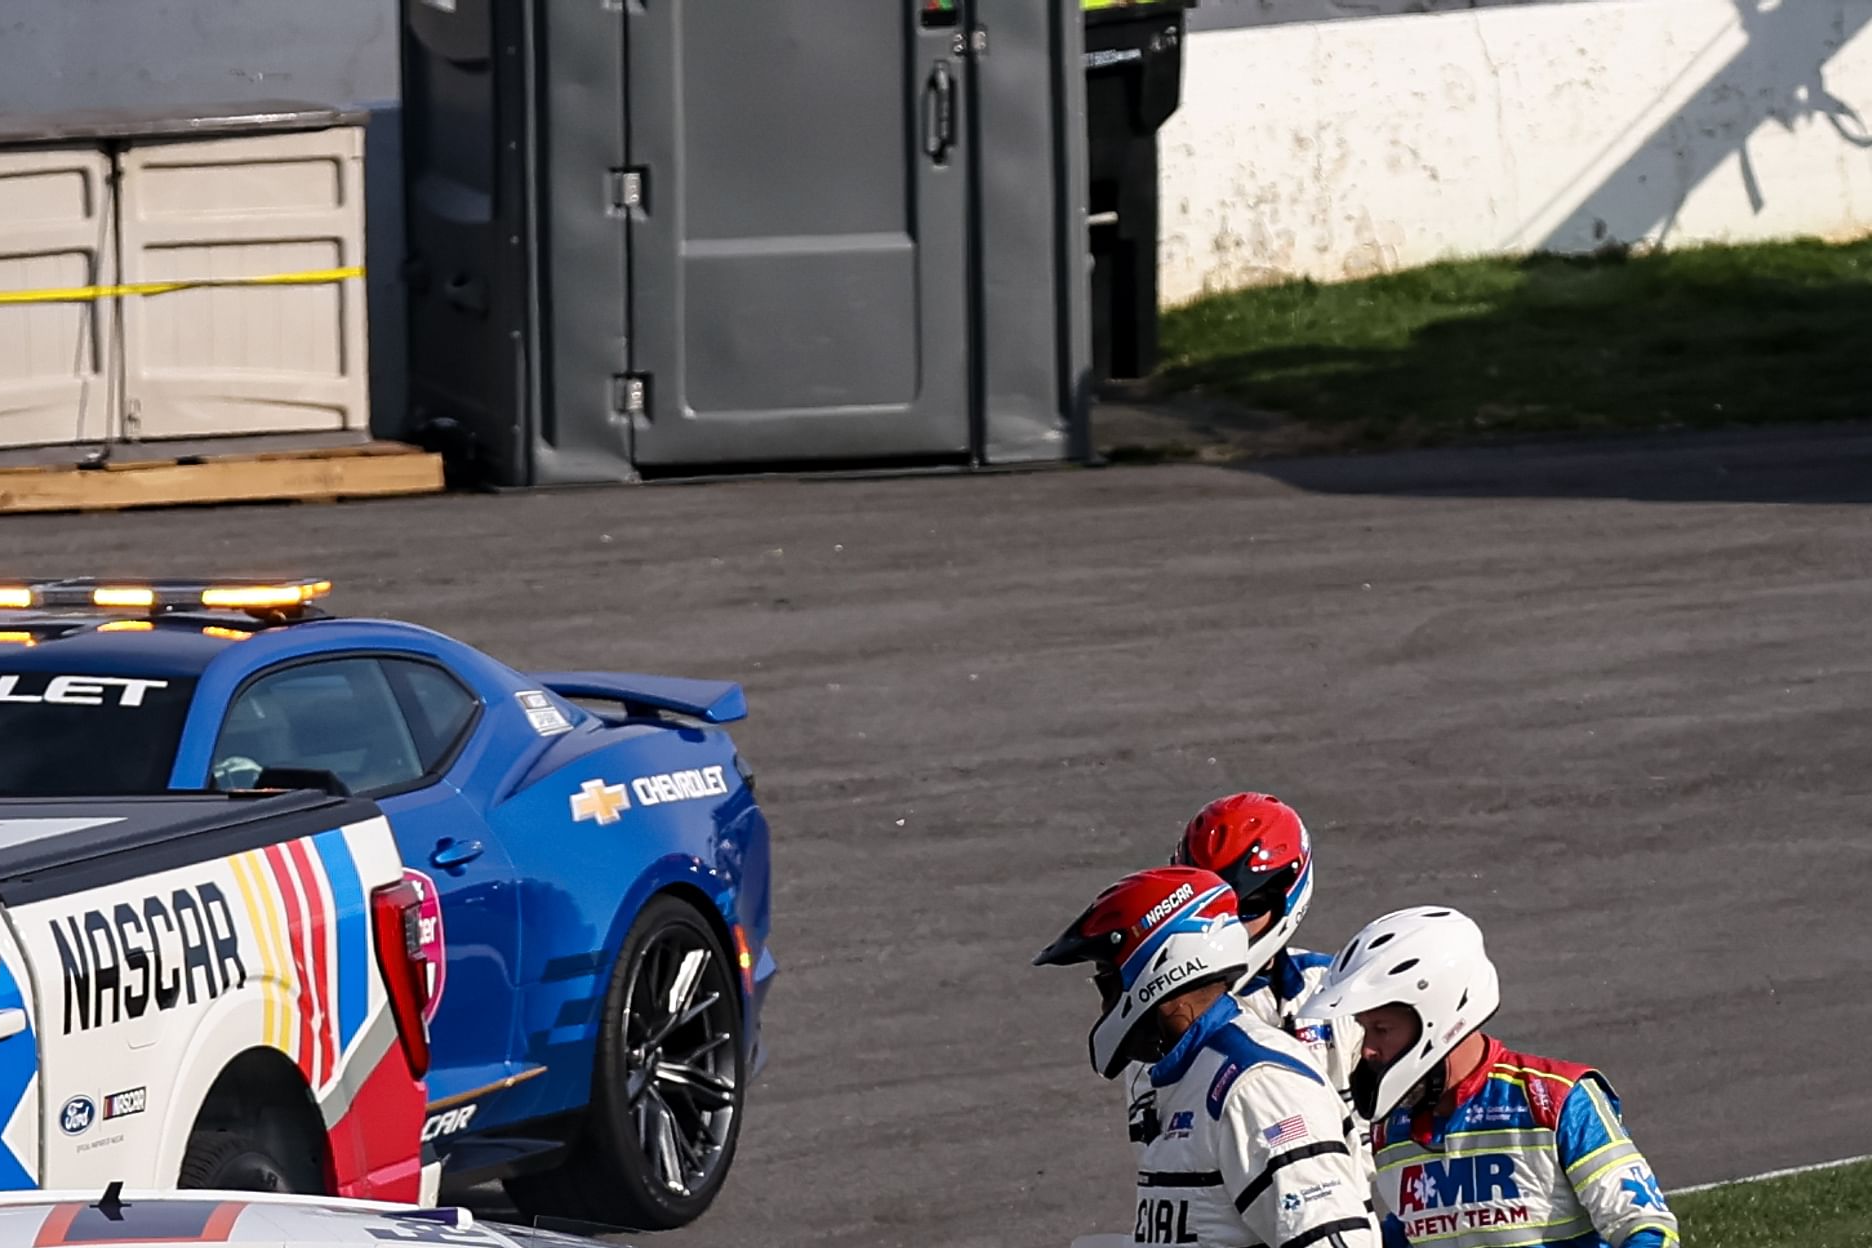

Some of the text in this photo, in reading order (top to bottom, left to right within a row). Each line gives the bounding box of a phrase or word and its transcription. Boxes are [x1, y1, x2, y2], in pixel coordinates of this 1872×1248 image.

[633, 765, 728, 806] CHEVROLET
[1146, 883, 1194, 926] NASCAR
[48, 882, 247, 1035] NASCAR
[1138, 957, 1208, 1003] OFFICIAL
[64, 1102, 90, 1130] Ford
[421, 1104, 477, 1142] CAR
[1398, 1153, 1521, 1217] AMR
[1464, 1205, 1528, 1228] TEAM
